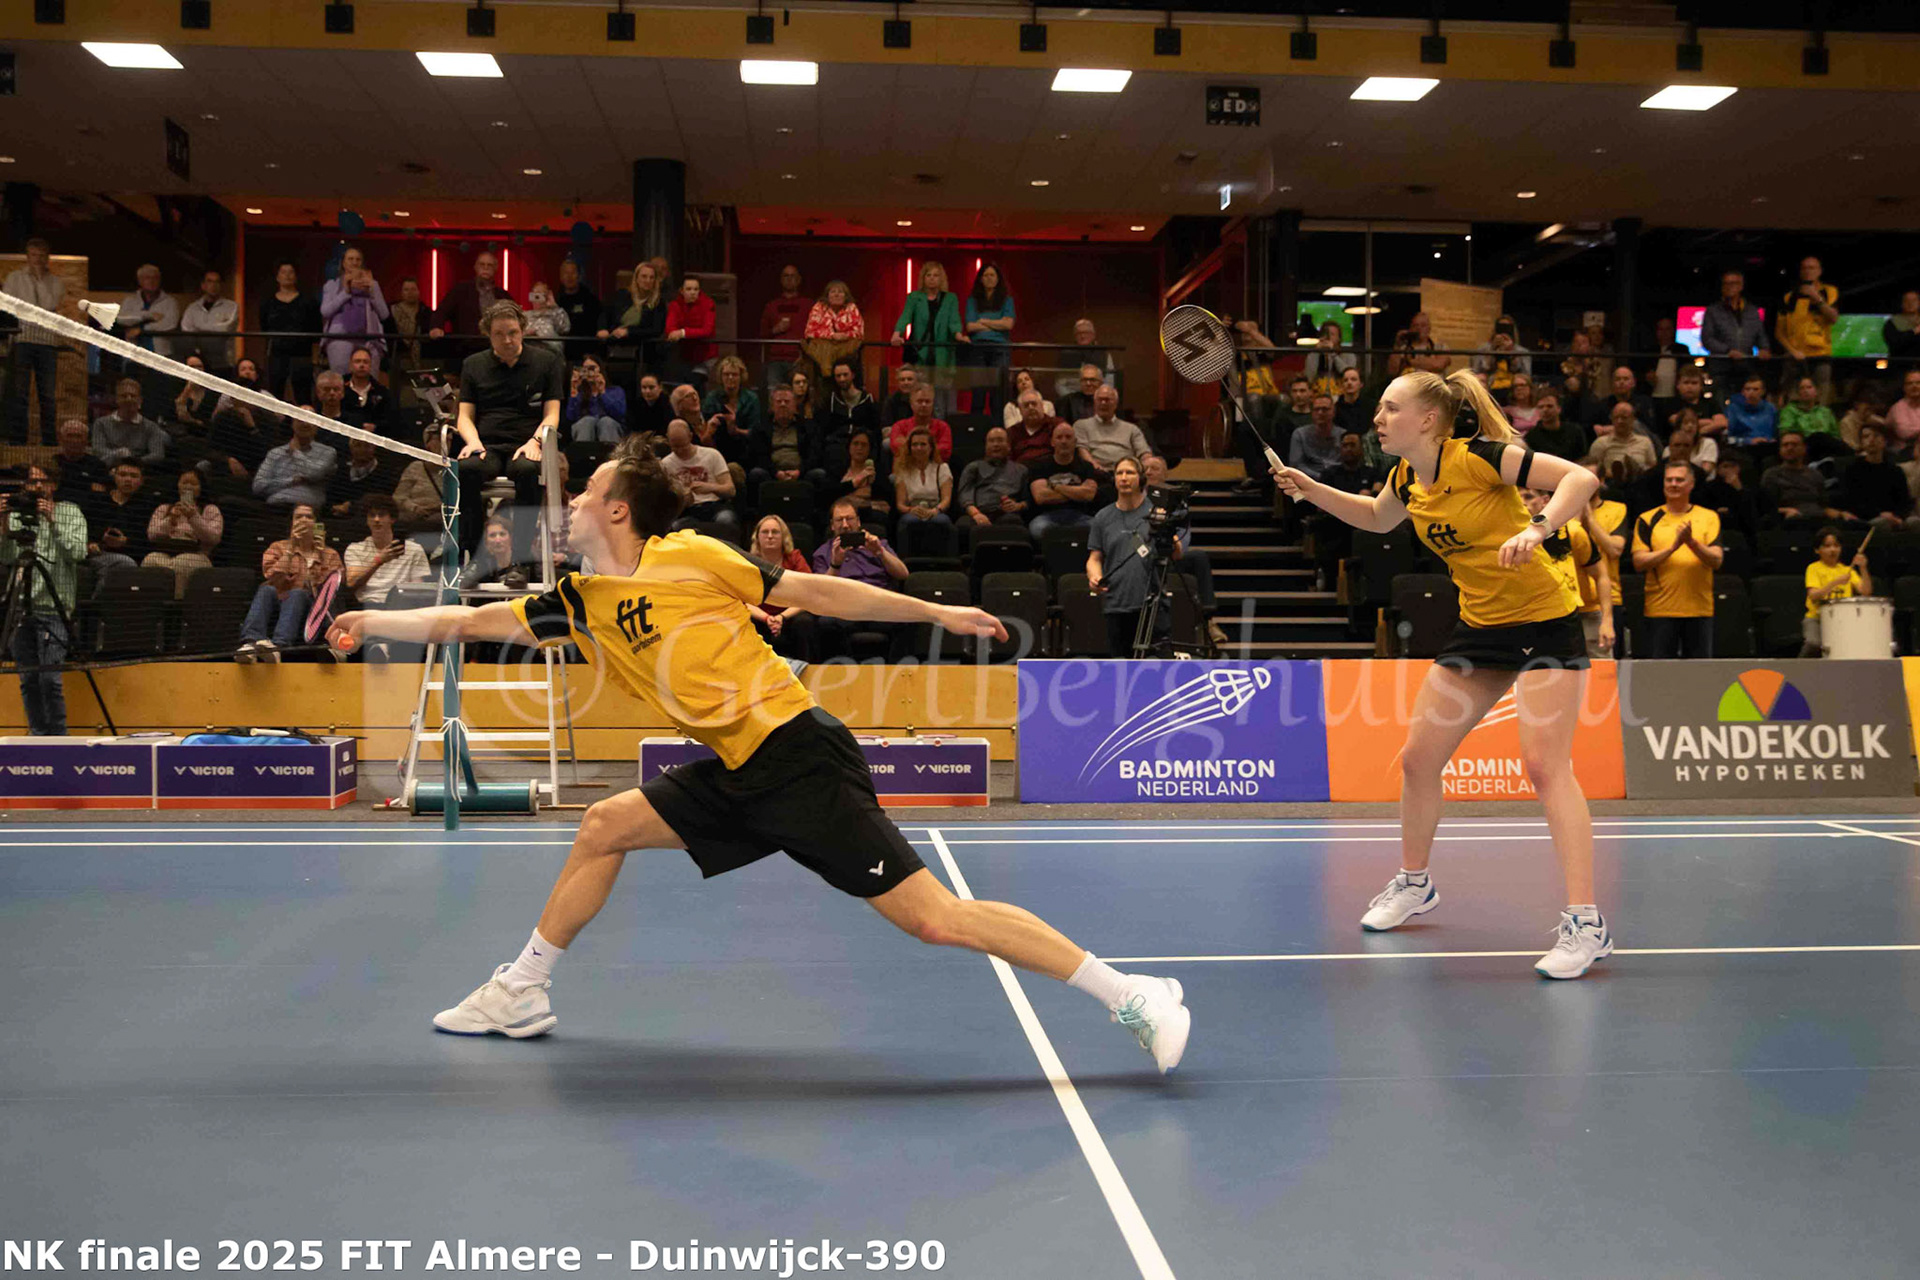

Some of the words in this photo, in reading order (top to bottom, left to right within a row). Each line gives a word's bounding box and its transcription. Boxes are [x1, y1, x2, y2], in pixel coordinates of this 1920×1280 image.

[1643, 724, 1891, 760] VANDEKOLK
[6, 765, 54, 775] VICTOR
[89, 765, 136, 775] VICTOR
[189, 766, 235, 775] VICTOR
[269, 766, 315, 775] VICTOR
[928, 764, 972, 774] VICTOR
[1119, 760, 1275, 778] BADMINTON
[1441, 758, 1523, 776] ADMIN
[1675, 764, 1866, 781] HYPOTHEKEN
[1137, 781, 1259, 796] NEDERLAND
[1442, 779, 1536, 794] NEDERLA
